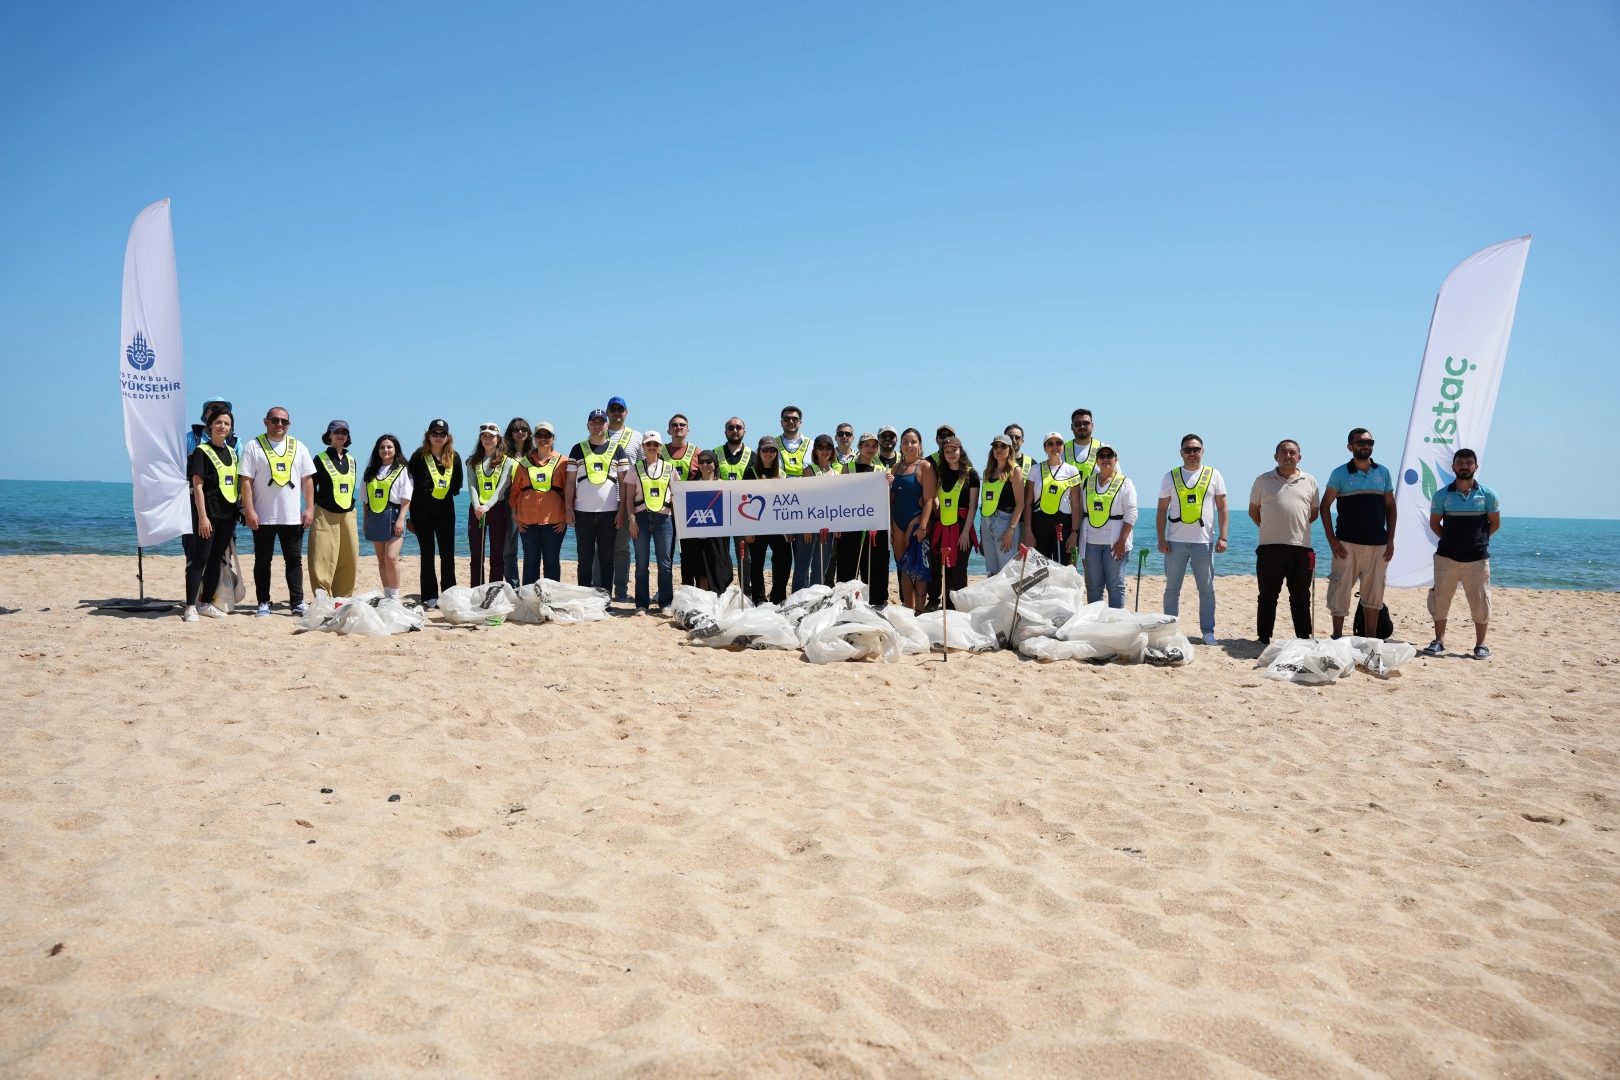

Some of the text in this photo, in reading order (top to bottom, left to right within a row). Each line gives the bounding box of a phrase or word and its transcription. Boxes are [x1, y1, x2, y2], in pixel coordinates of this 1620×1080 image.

[120, 379, 180, 393] YÜKŞEHİR
[1424, 356, 1477, 444] istaç
[773, 494, 800, 506] AXA
[686, 509, 718, 525] AXA
[773, 503, 875, 522] Tüm Kalplerde
